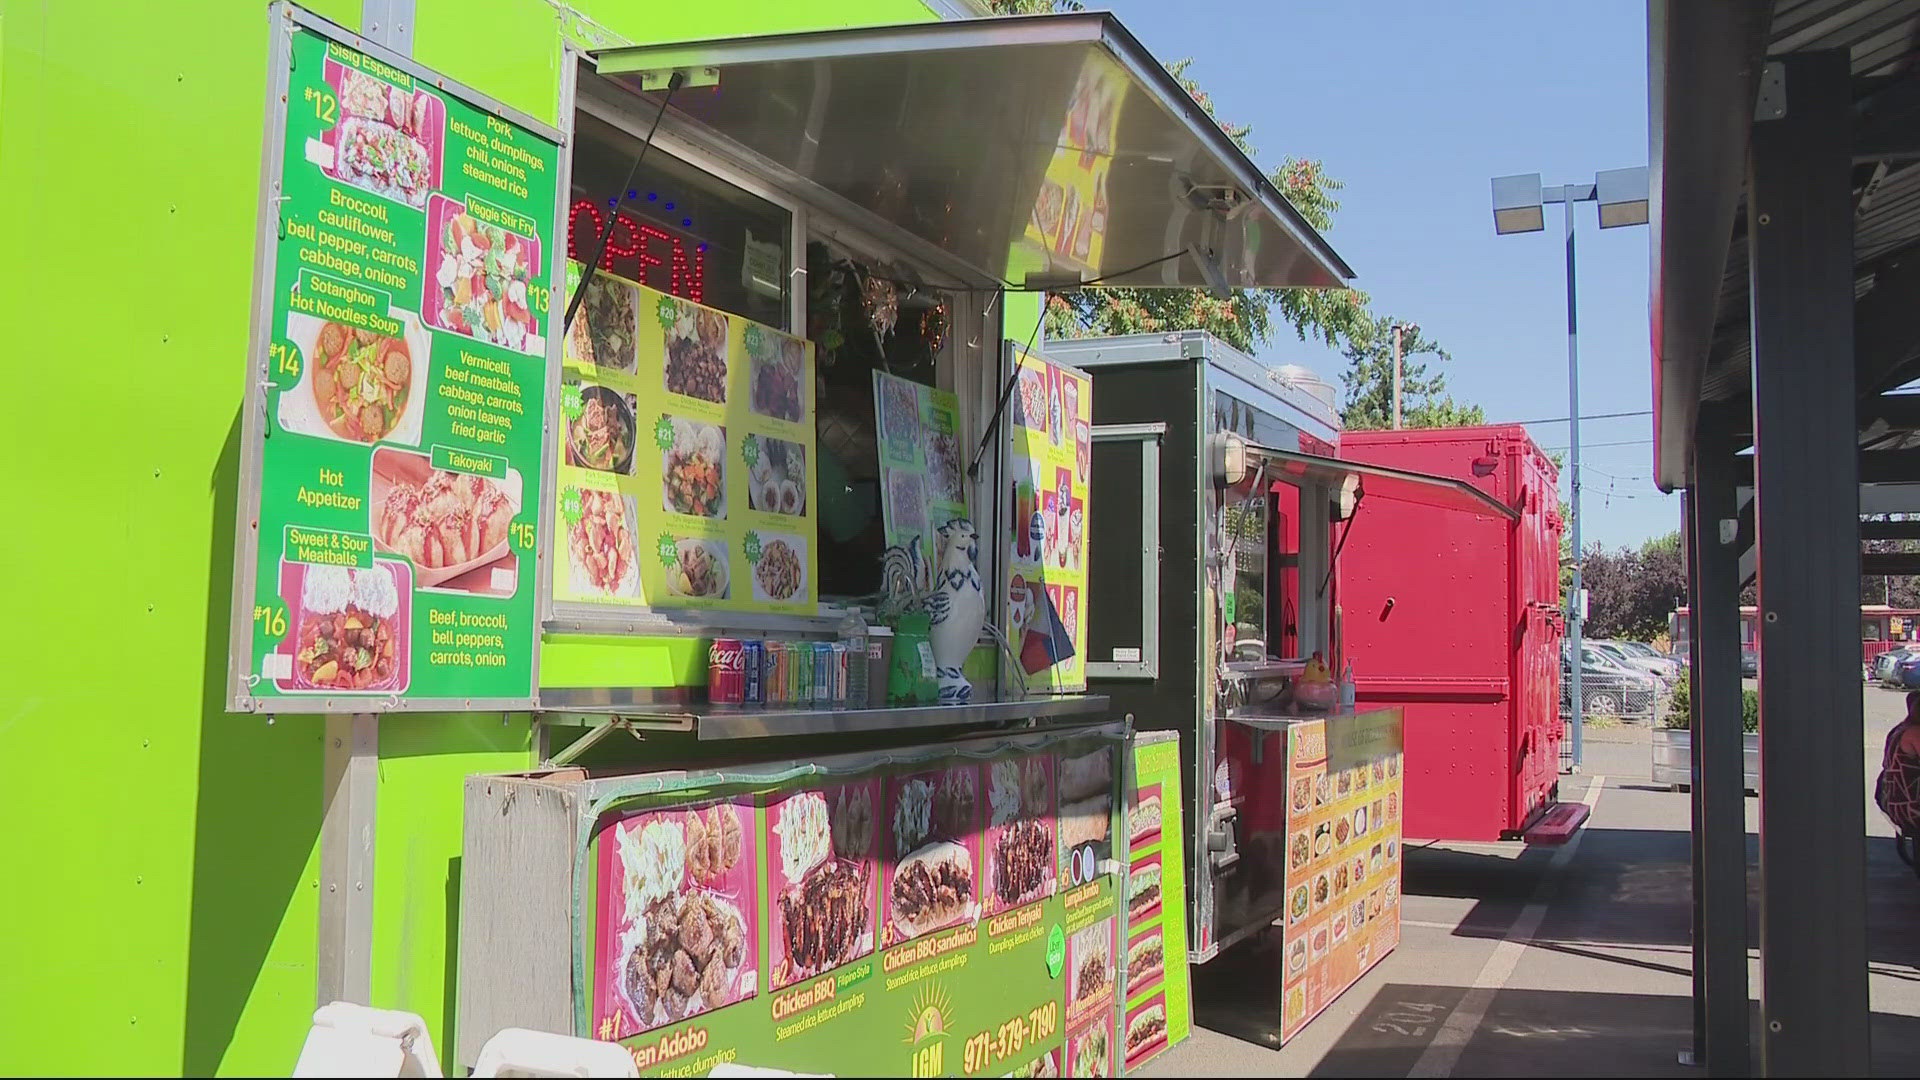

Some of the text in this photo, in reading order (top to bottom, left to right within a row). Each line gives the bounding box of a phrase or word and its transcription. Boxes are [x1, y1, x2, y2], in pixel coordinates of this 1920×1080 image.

[329, 40, 411, 87] Sisig Especial
[304, 87, 336, 124] #12
[486, 116, 513, 140] Pork,
[450, 117, 545, 172] lettuce, dumplings,
[466, 147, 527, 182] chili, onions,
[462, 163, 528, 199] steamed rice
[330, 188, 388, 224] Broccoli,
[467, 200, 534, 237] Veggie Stir Fry
[318, 209, 396, 247] cauliflower,
[287, 219, 418, 276] bell pepper, carrots,
[567, 200, 703, 304] OPEN
[299, 247, 407, 290] cabbage, onions
[310, 276, 376, 307] Sotanghon
[527, 284, 550, 313] #13
[290, 292, 399, 334] Hot Noodles Soup
[660, 307, 674, 320] #20
[269, 343, 300, 377] #14
[460, 350, 512, 379] Vermicelli,
[445, 364, 522, 398] beef meatballs,
[438, 383, 524, 415] cabbage, carrots,
[564, 393, 580, 407] #18
[447, 403, 513, 431] onion leaves,
[451, 421, 506, 445] fried garlic
[658, 430, 671, 440] #21
[447, 450, 493, 473] Takoyaki
[319, 468, 343, 487] Hot
[297, 488, 361, 512] Appetizer
[564, 499, 580, 512] #19
[290, 530, 369, 552] Sweet & Sour
[510, 523, 534, 549] #15
[660, 543, 675, 556] #22
[298, 547, 358, 566] Meatballs
[253, 605, 286, 636] #16
[429, 609, 508, 632] Beef, broccoli,
[432, 629, 505, 651] bell peppers,
[430, 650, 506, 667] carrots, onion
[983, 891, 995, 915] #4
[881, 921, 893, 946] #3
[989, 914, 1017, 937] Chicken
[1017, 903, 1042, 928] Teriyaki
[884, 946, 916, 971] Chicken
[916, 938, 937, 960] BBQ
[772, 958, 788, 986] #2
[886, 970, 909, 991] Steamed
[772, 977, 835, 1019] Chicken BBQ
[599, 1008, 621, 1040] #1
[776, 1016, 805, 1041] Steamed
[837, 992, 865, 1014] dumplings
[658, 1028, 706, 1061] Adobo
[964, 1001, 1056, 1075] 971-379-7190
[693, 1047, 736, 1075] dumplings
